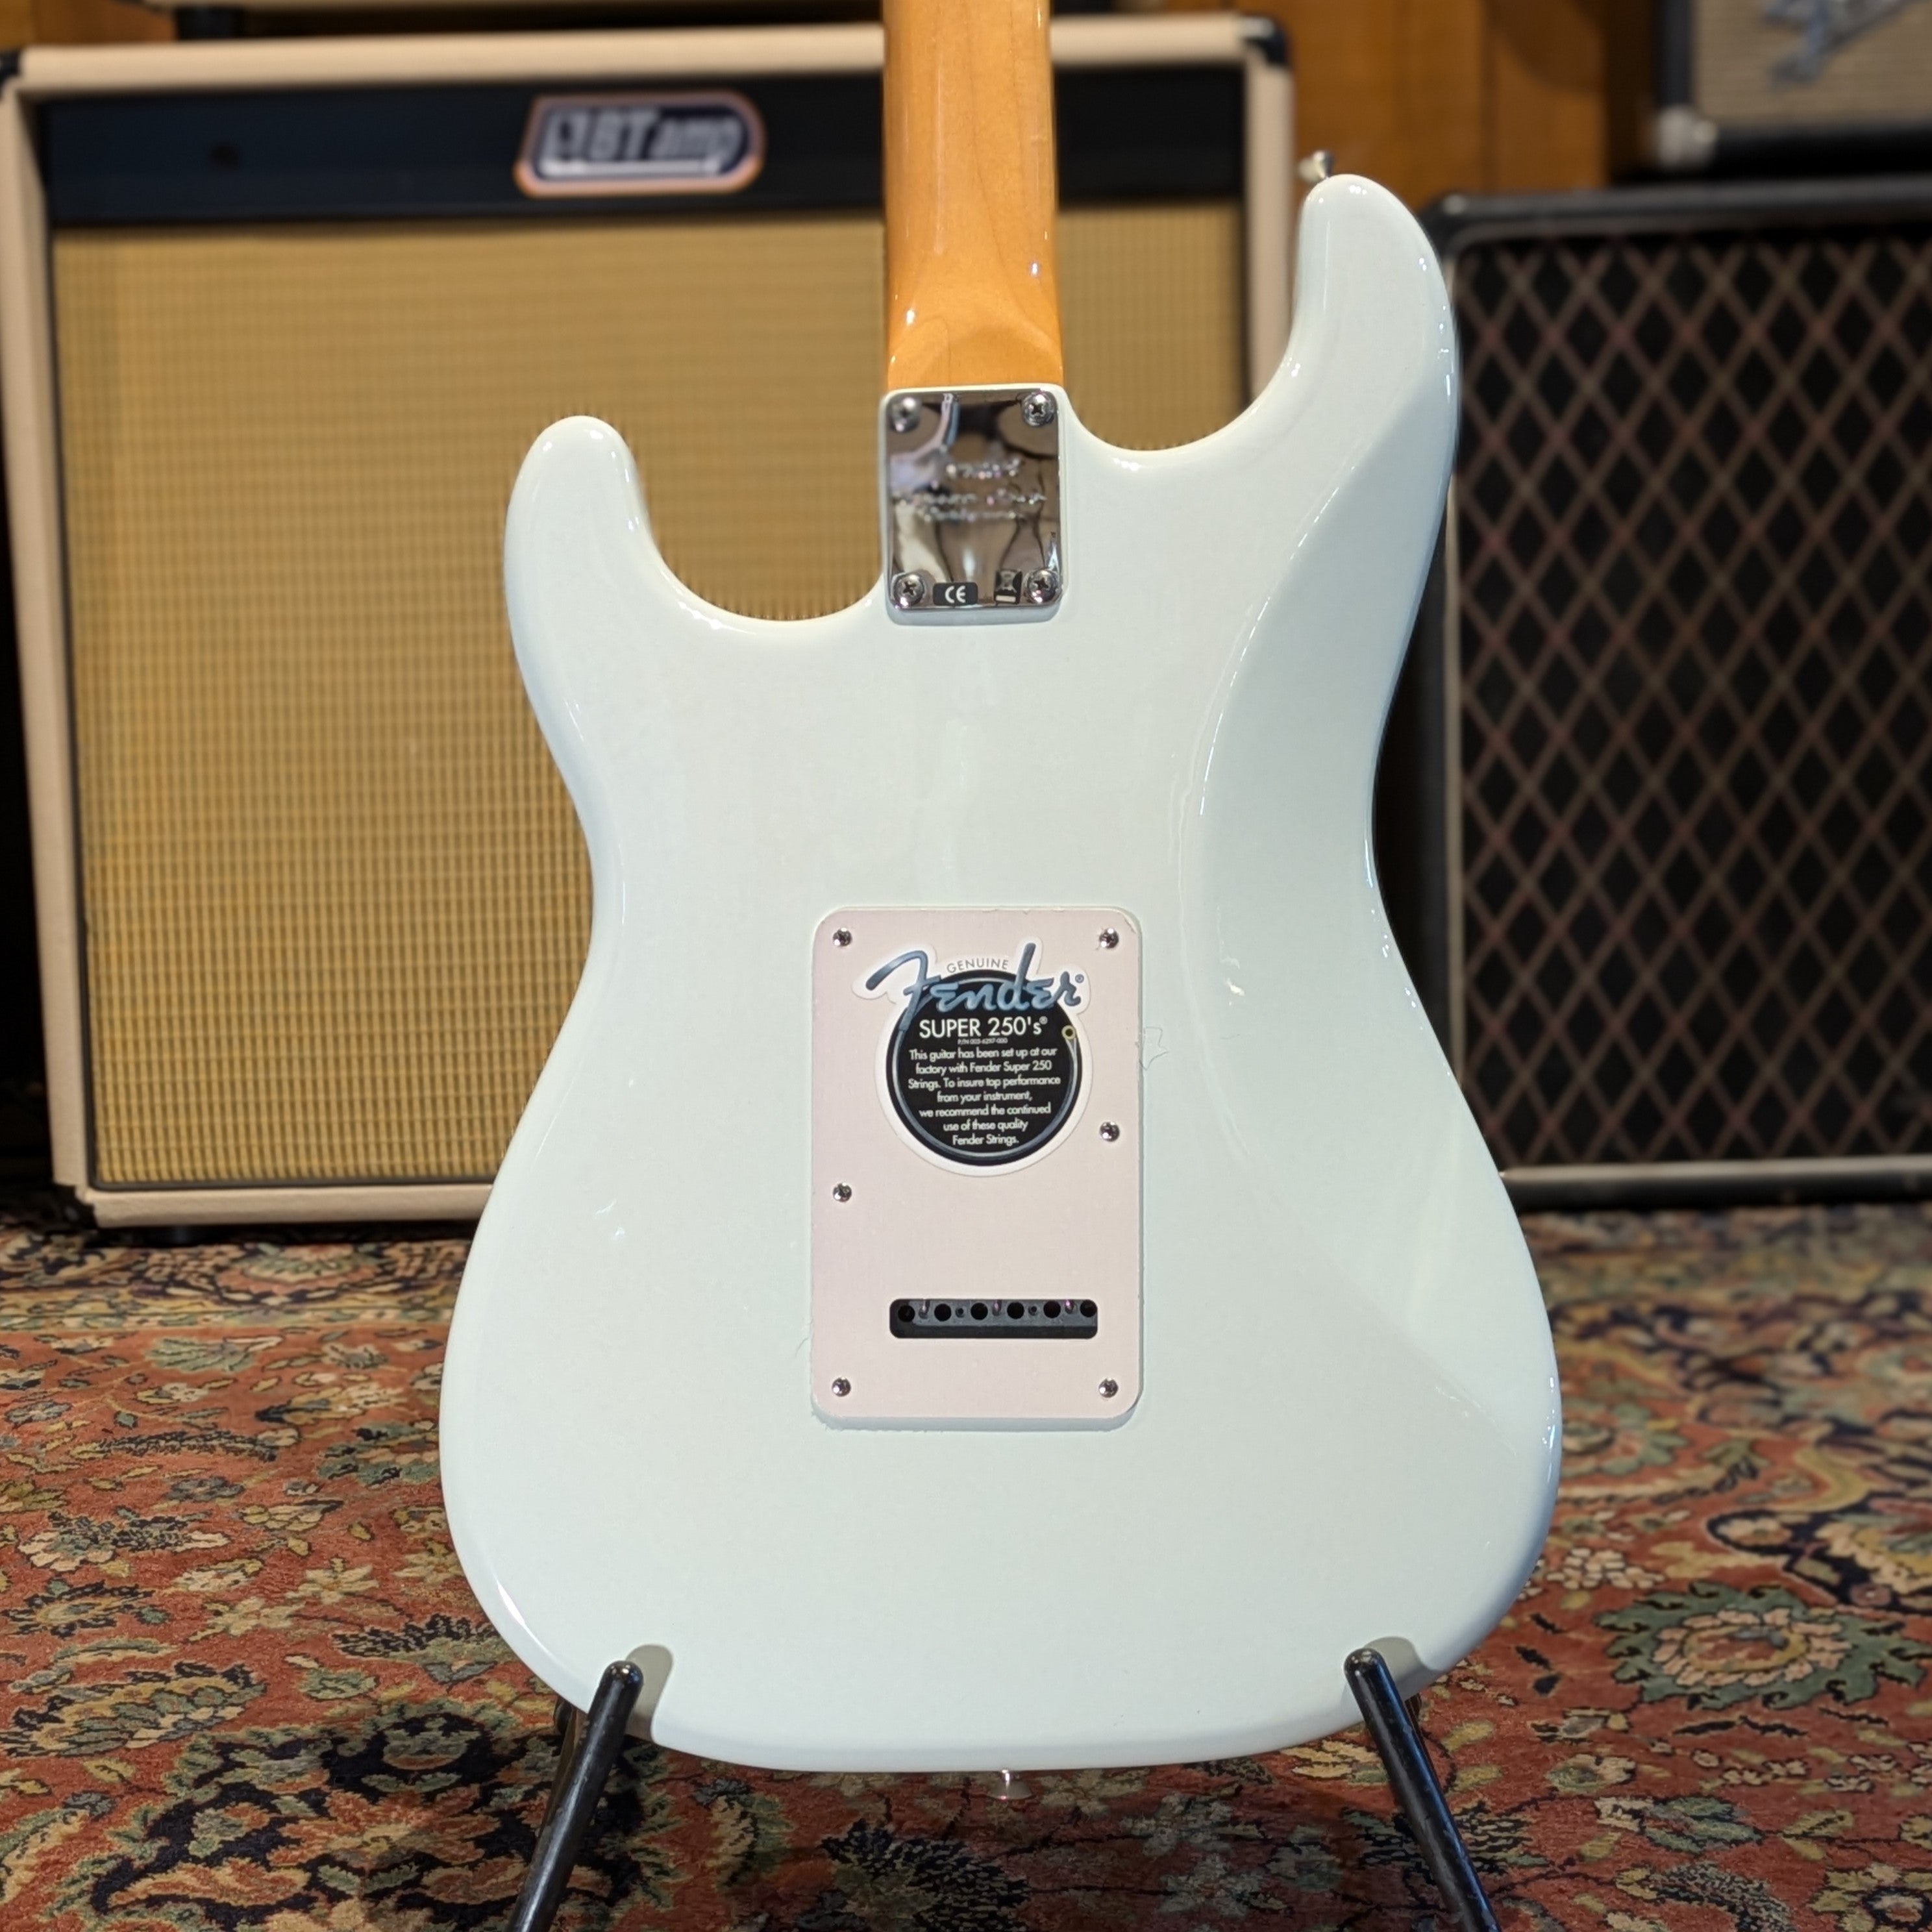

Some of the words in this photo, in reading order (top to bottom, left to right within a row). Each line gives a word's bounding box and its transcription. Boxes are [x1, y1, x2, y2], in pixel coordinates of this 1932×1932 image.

[945, 586, 966, 603] CE
[947, 958, 1009, 973] GENUINE
[919, 1018, 982, 1038] SUPER
[909, 1048, 928, 1060] This
[929, 1048, 956, 1063] guitar
[958, 1046, 974, 1058] has
[976, 1046, 1000, 1058] been
[1001, 1047, 1014, 1058] set
[1015, 1049, 1028, 1059] up
[1030, 1046, 1040, 1057] at
[1041, 1048, 1058, 1056] our
[916, 1062, 947, 1076] factory
[948, 1061, 968, 1073] with
[969, 1059, 1002, 1072] Fender
[1003, 1060, 1030, 1074] Super
[1032, 1059, 1052, 1071] 250
[908, 1078, 941, 1092] Strings.
[943, 1077, 956, 1088] To
[957, 1077, 984, 1087] insure
[985, 1078, 1001, 1089] top
[1003, 1073, 1061, 1089] performance
[937, 1090, 959, 1102] from
[960, 1093, 982, 1105] your
[983, 1090, 1033, 1102] instrument,
[935, 1103, 989, 1117] recommend
[991, 1104, 1006, 1115] the
[1007, 1101, 1051, 1115] continued
[943, 1123, 960, 1132] use
[961, 1118, 971, 1131] of
[972, 1118, 996, 1130] these
[997, 1117, 1029, 1132] quality
[952, 1133, 985, 1145] Fender
[986, 1133, 1019, 1146] Strings.
